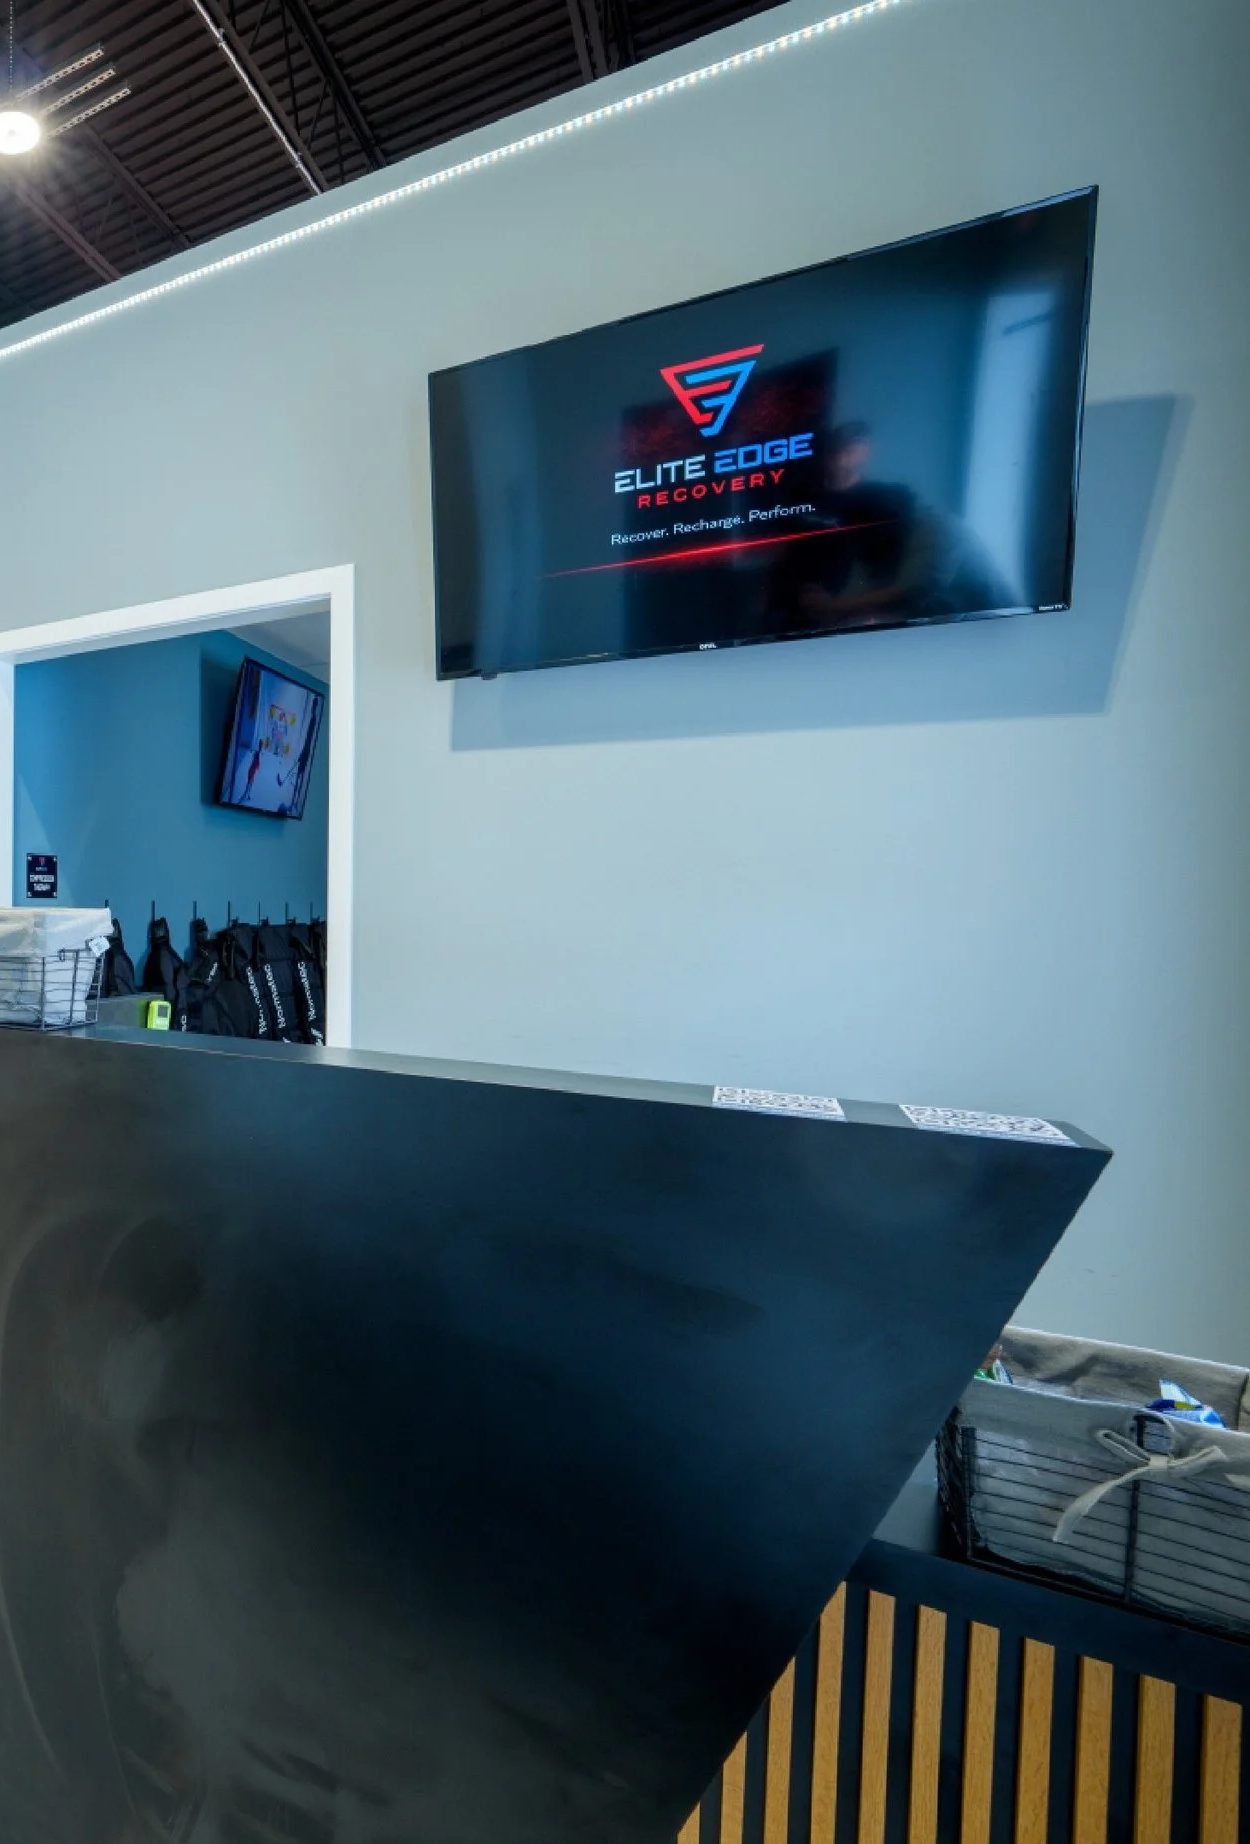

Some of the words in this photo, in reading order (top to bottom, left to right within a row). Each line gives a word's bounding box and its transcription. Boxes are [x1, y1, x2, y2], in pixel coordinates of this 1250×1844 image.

[614, 454, 706, 494] ELITE
[714, 432, 814, 474] EDGE
[637, 468, 786, 510] RECOVERY
[611, 527, 670, 545] Recover.
[673, 516, 745, 536] Recharge.
[748, 503, 816, 522] Perform.
